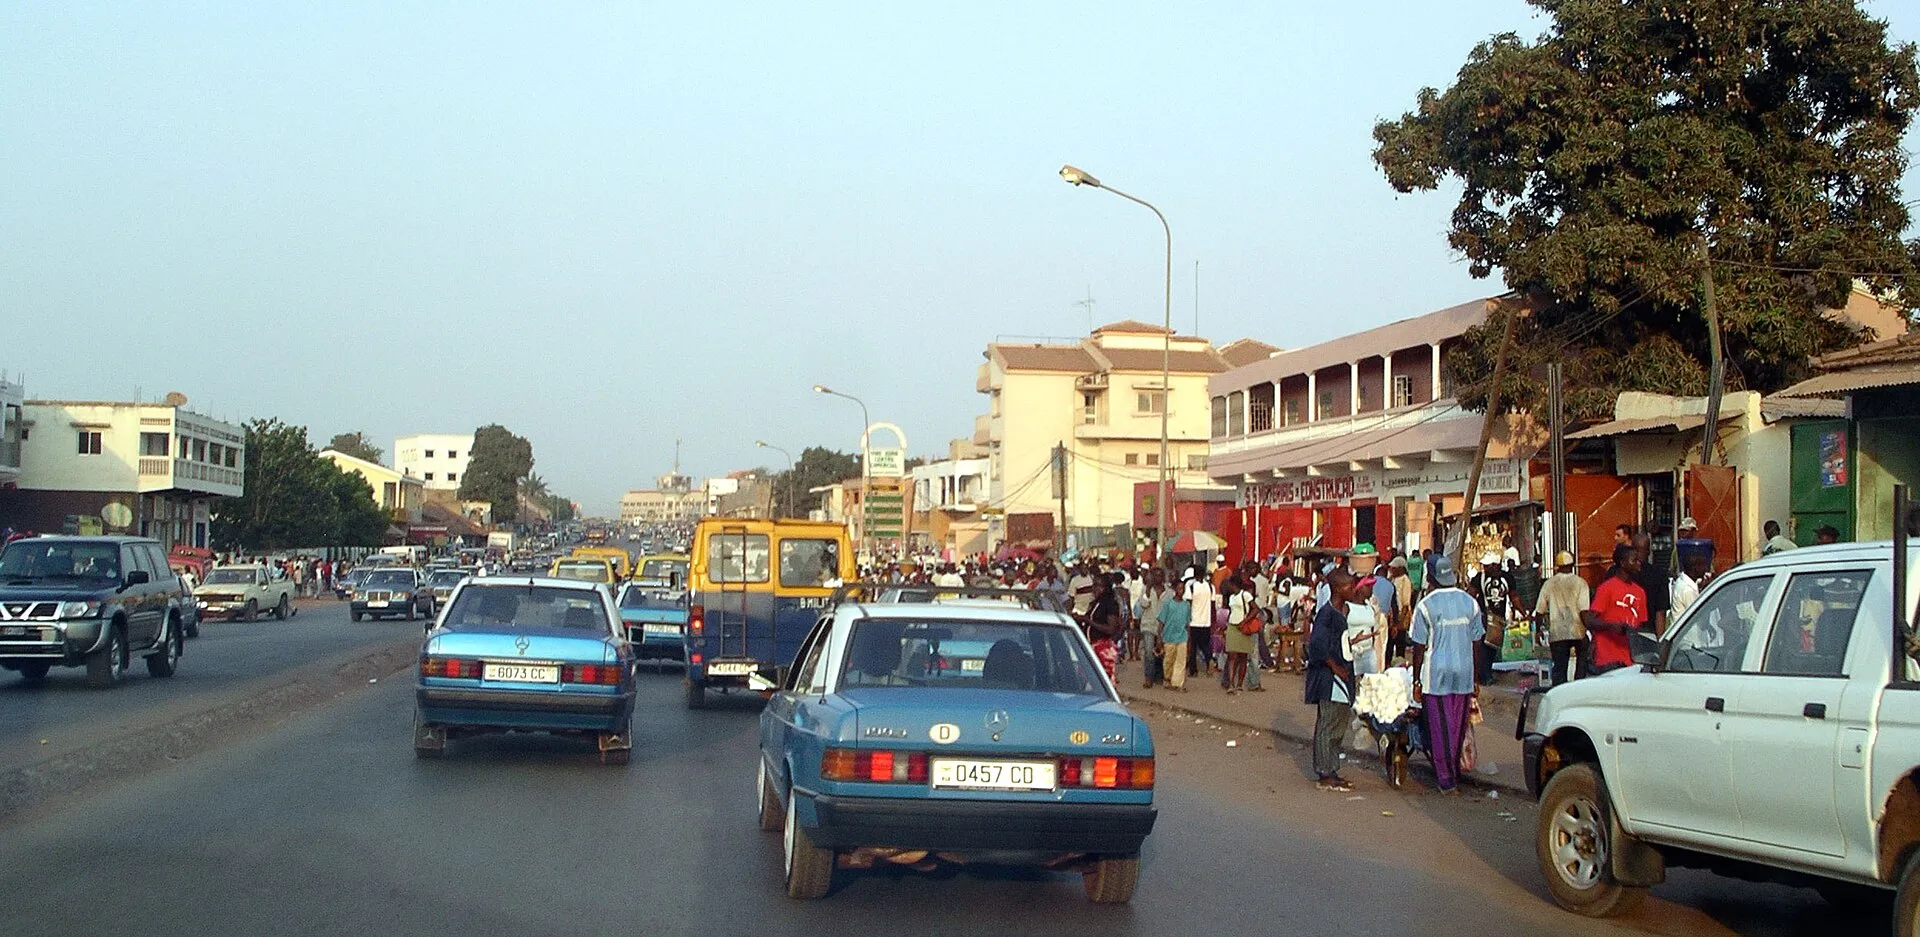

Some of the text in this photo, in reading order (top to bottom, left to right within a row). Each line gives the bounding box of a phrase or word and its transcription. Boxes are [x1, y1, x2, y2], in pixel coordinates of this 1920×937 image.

[498, 666, 545, 679] 6073 CC
[940, 725, 950, 740] D
[956, 764, 1002, 783] 0457
